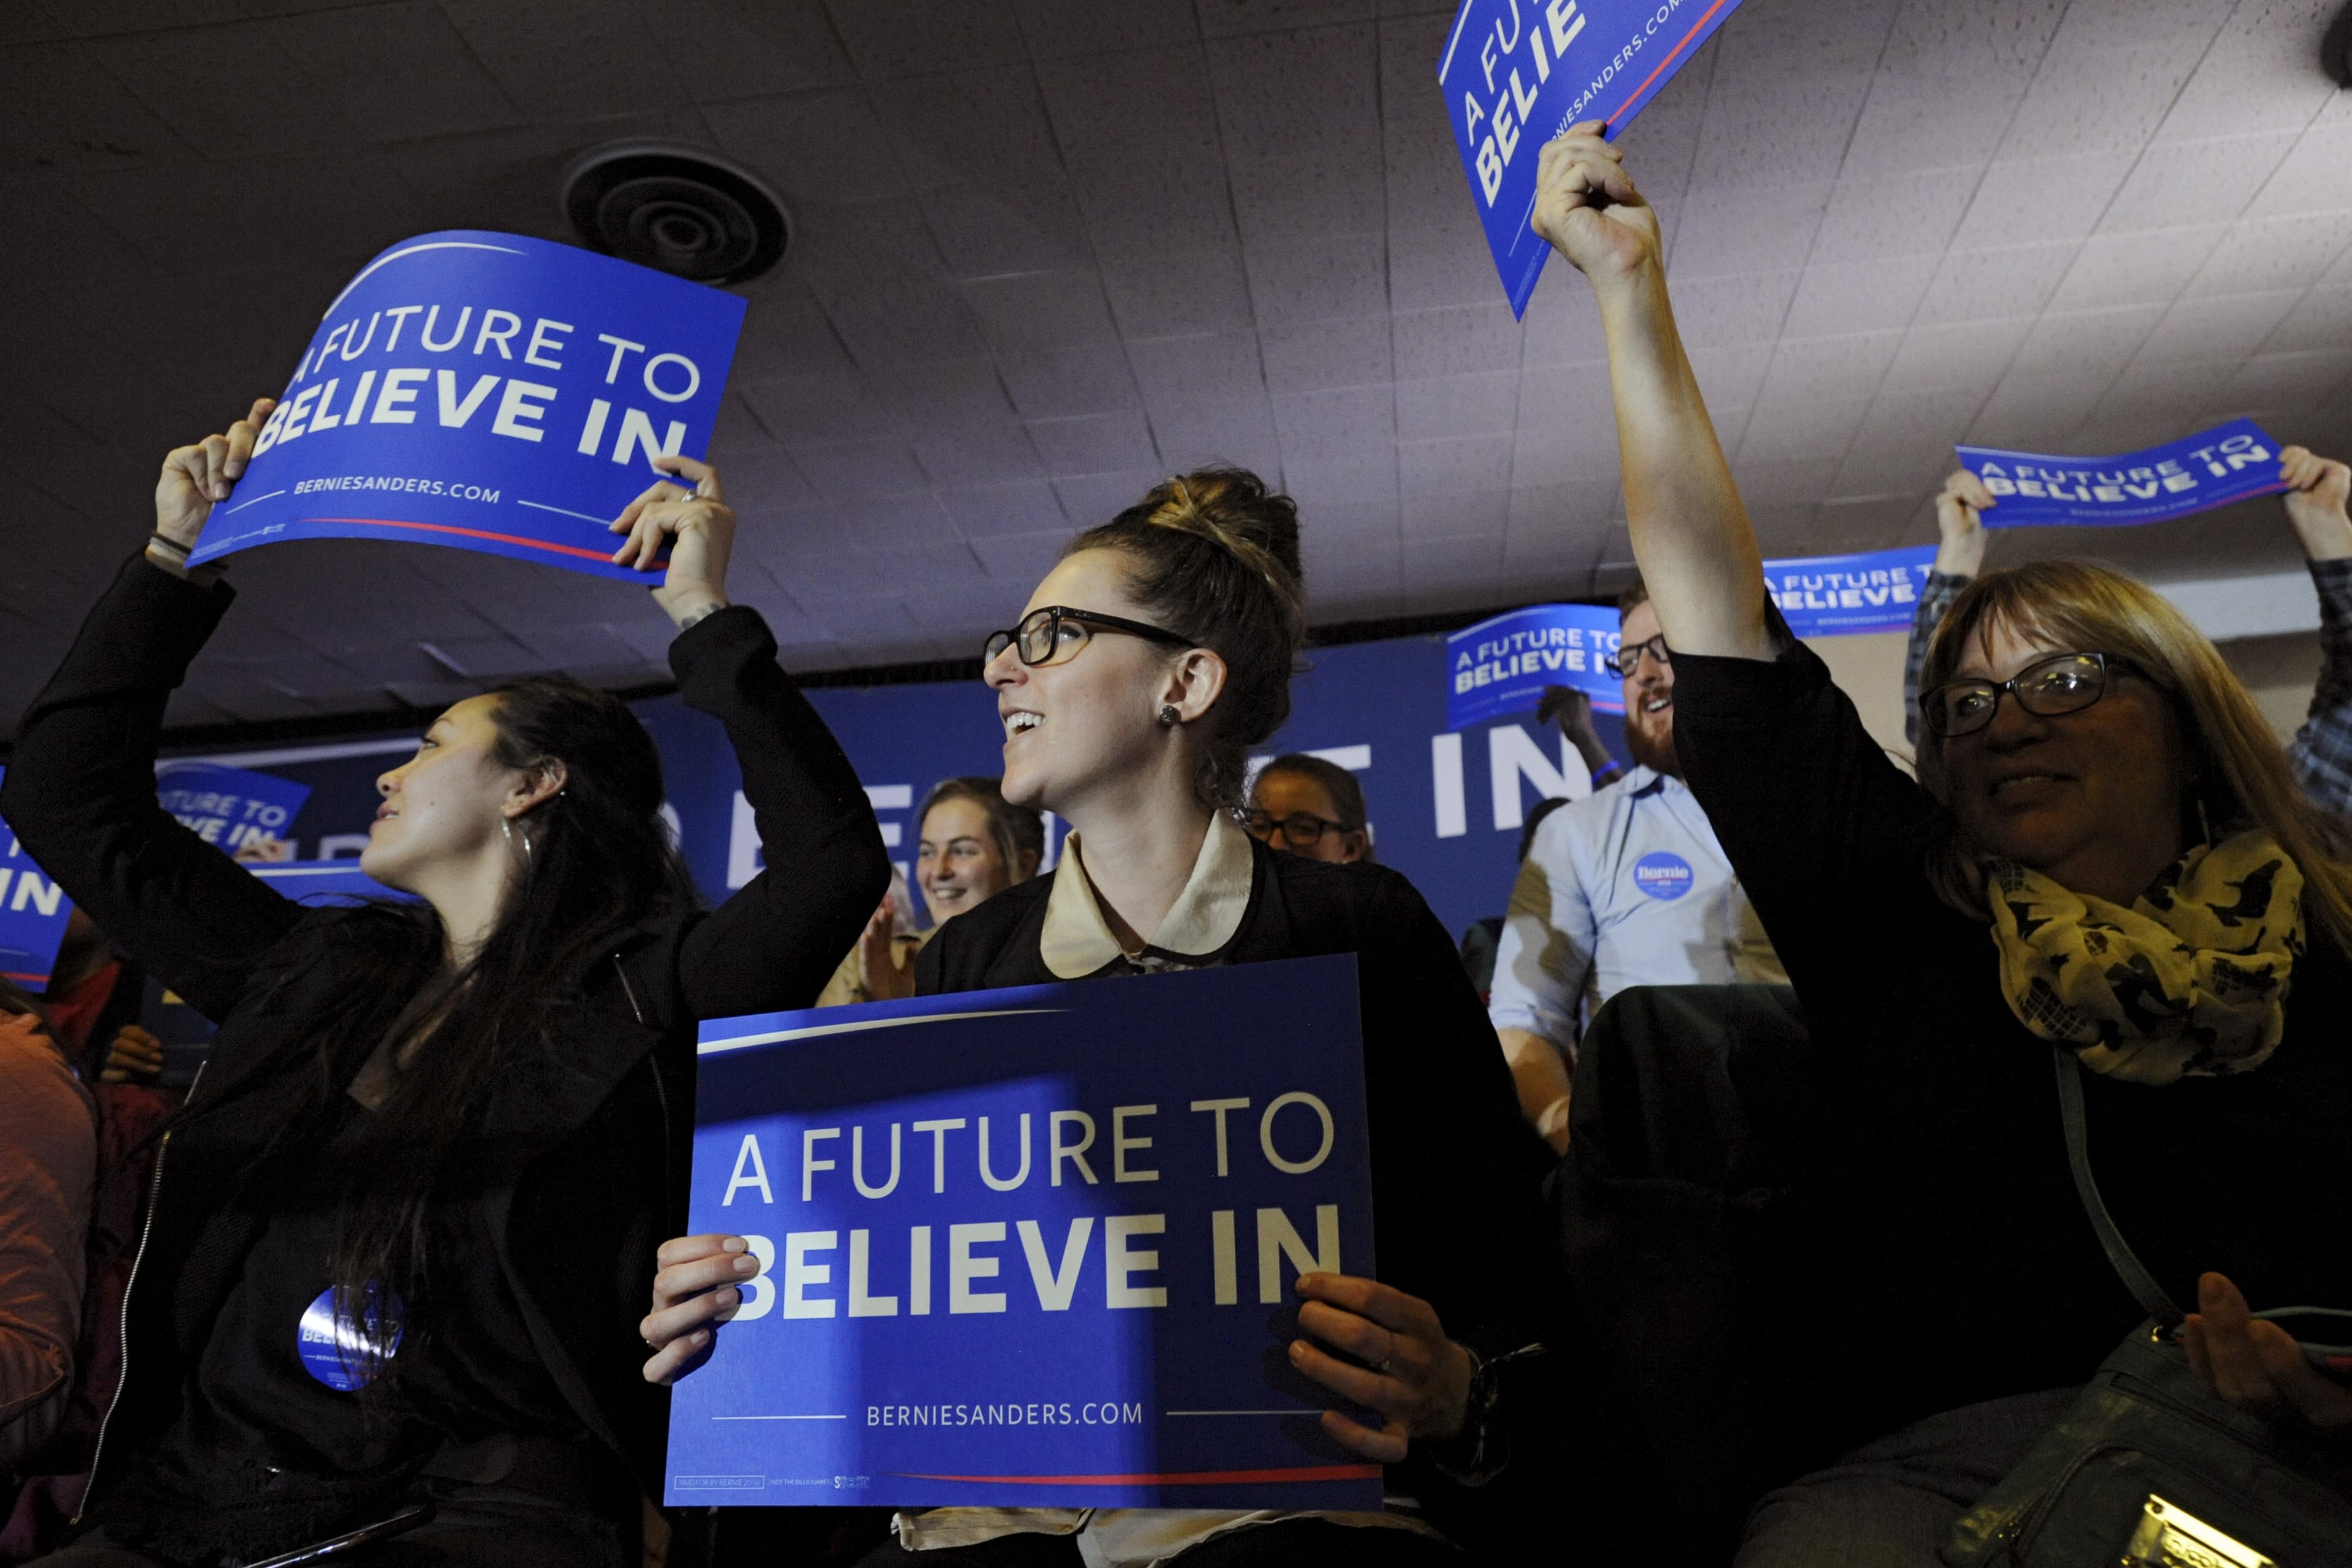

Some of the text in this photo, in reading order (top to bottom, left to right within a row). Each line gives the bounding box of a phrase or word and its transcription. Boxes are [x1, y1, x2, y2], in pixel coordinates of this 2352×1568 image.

[1465, 91, 1485, 146] A
[285, 304, 700, 403] A FUTURE TO
[251, 368, 687, 478] BELIEVE IN
[1981, 434, 2253, 485] A FUTURE TO
[1983, 444, 2271, 502] BELIEVE IN
[294, 476, 500, 504] BERNIESANDERS.COM
[1784, 567, 1910, 592] FUTURE
[1455, 648, 1586, 695] BELIEVE
[1456, 650, 1472, 671] A
[1477, 627, 1583, 662] FUTURE
[1431, 723, 1593, 839] IN
[244, 799, 287, 827] TO
[722, 1091, 1335, 1207] A FUTURE TO
[715, 1204, 1341, 1322] BELIEVE IN
[867, 1402, 1143, 1427] BERNIESANDERS.COM
